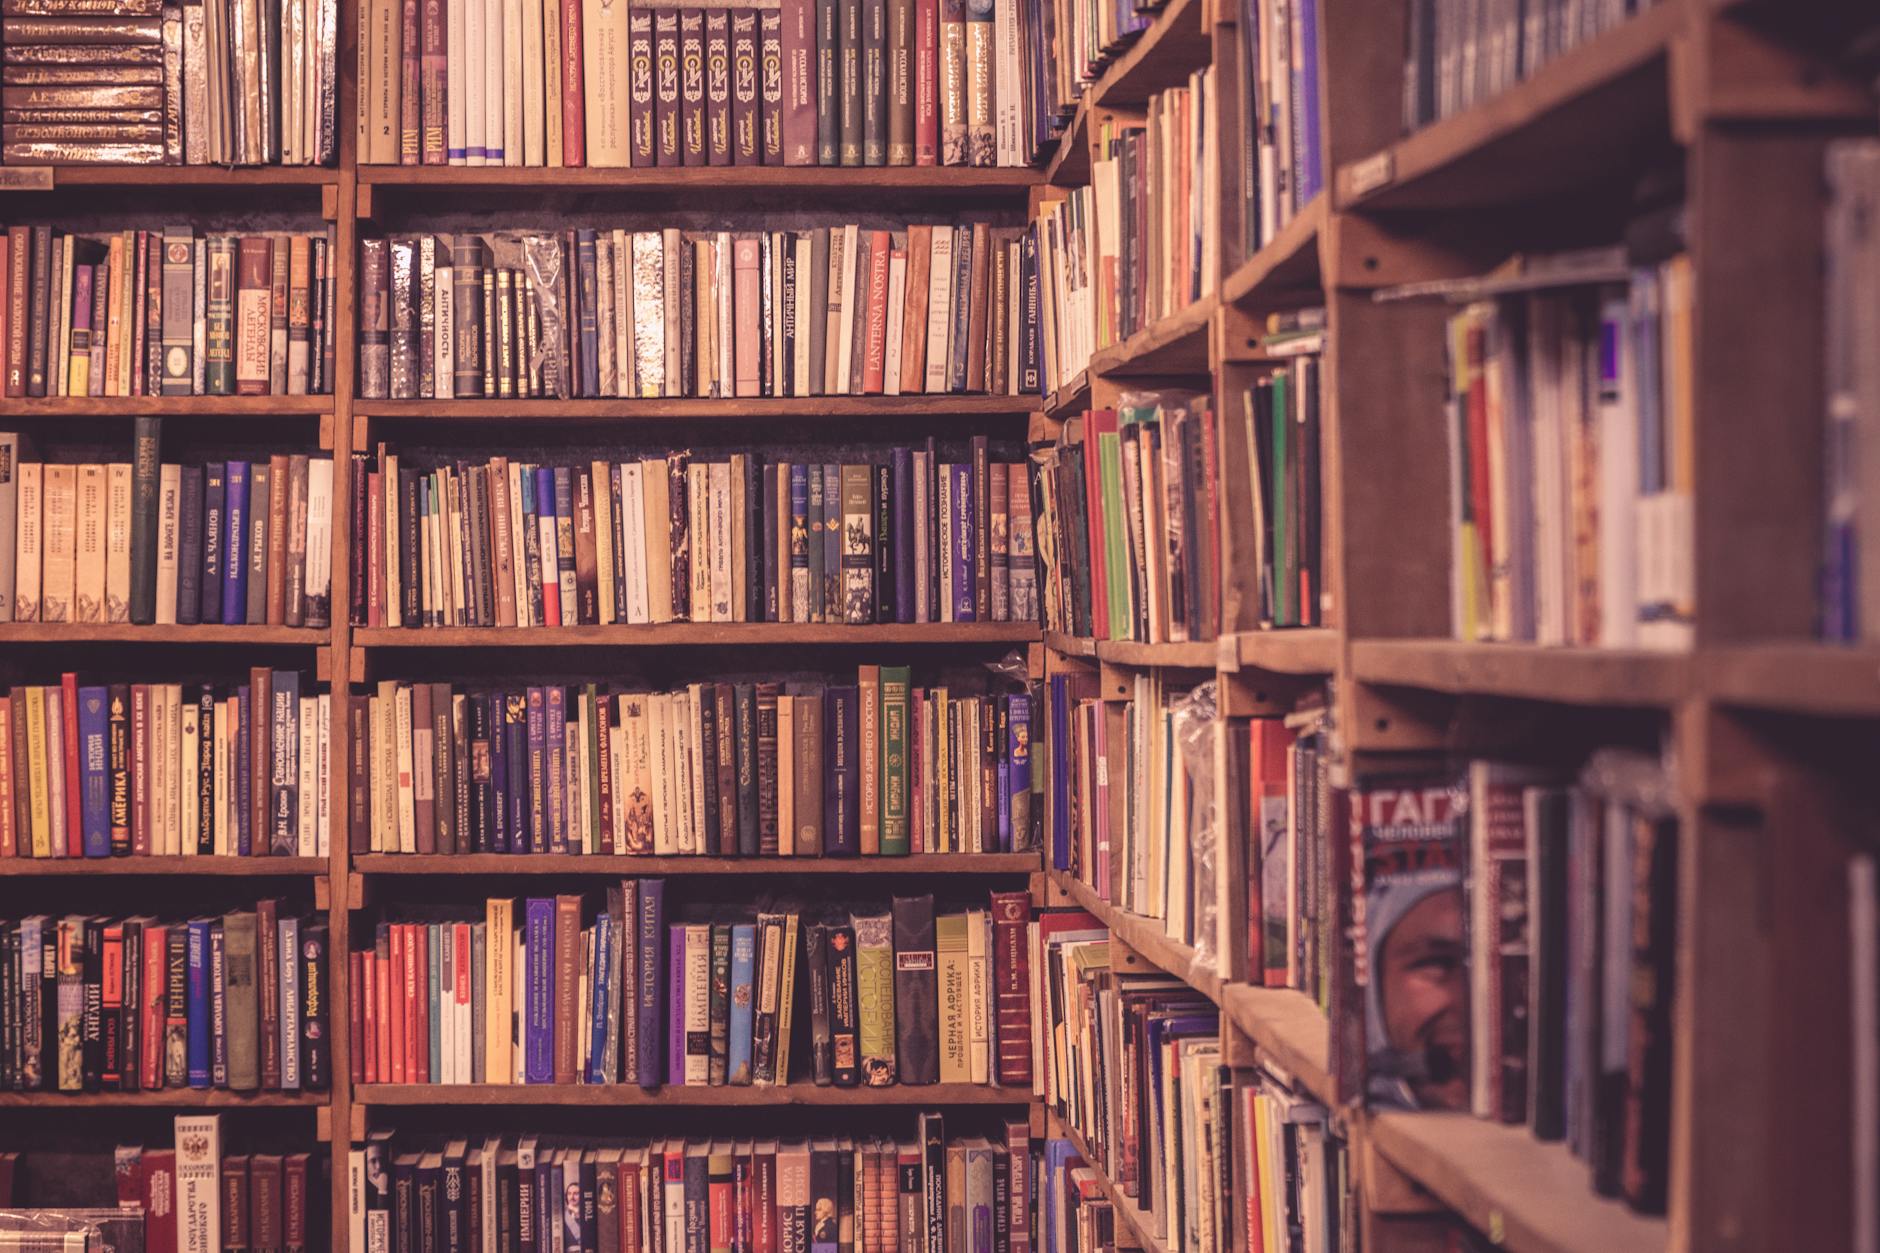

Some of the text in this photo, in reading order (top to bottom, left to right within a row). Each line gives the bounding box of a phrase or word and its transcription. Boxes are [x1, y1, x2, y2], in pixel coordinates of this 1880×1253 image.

[441, 289, 449, 359] АНТИЧНОСТЬ
[785, 257, 795, 338] АНТИЧНЫЙ МИР
[870, 250, 885, 371] LANTERNA NOSTRA
[1028, 275, 1037, 324] ГАННИБАЛ
[246, 308, 256, 363] ЛЕГЕНДЫ
[256, 295, 267, 376] МОСКОВСКИЕ
[209, 509, 218, 575] А. В. ЧАЯНОВ
[255, 520, 264, 552] РЫКОВ
[940, 475, 949, 580] ИСТОРИЧЕСКОЕ ПОЗНАНИЕ
[136, 729, 144, 761] АМЕРИКА
[272, 692, 285, 786] Становление нации
[600, 706, 608, 748] ФАРАОНОВ
[865, 688, 873, 815] ИСТОРИЯ ДРЕВНЕГО ВОСТОКА
[890, 710, 900, 740] ИНДИЯ
[114, 771, 127, 826] АМЕРИКА
[136, 762, 144, 803] ЛАТИНСКАЯ
[201, 777, 212, 796] Рус
[278, 790, 289, 818] Ерохин
[602, 784, 609, 794] ВО
[278, 820, 288, 836] В.Н.
[644, 896, 655, 1008] ИСТОРИЯ КИТАЯ
[1010, 927, 1018, 969] БИЦИЛЛИ
[170, 943, 184, 1018] ГЕНРИХ II
[306, 961, 319, 1017] Реформация
[696, 953, 707, 1028] ИМПЕРИЯ
[879, 950, 893, 1054] ИССЛЕДОВАНИЕ
[88, 983, 100, 1041] АНГЛИИ
[214, 994, 223, 1036] КОРОЛЕВА
[946, 960, 957, 1059] ЧЕРНАЯ АФРИКА:
[975, 998, 983, 1038] ИСТОРИЯ
[520, 1183, 530, 1242] ИМПЕРИИ
[584, 1191, 593, 1222] ТОМ II
[783, 1166, 793, 1207] БОУРА
[796, 1166, 805, 1217] ПОЭЗИЯ
[187, 1180, 196, 1251] ГОСУДАРСТВА
